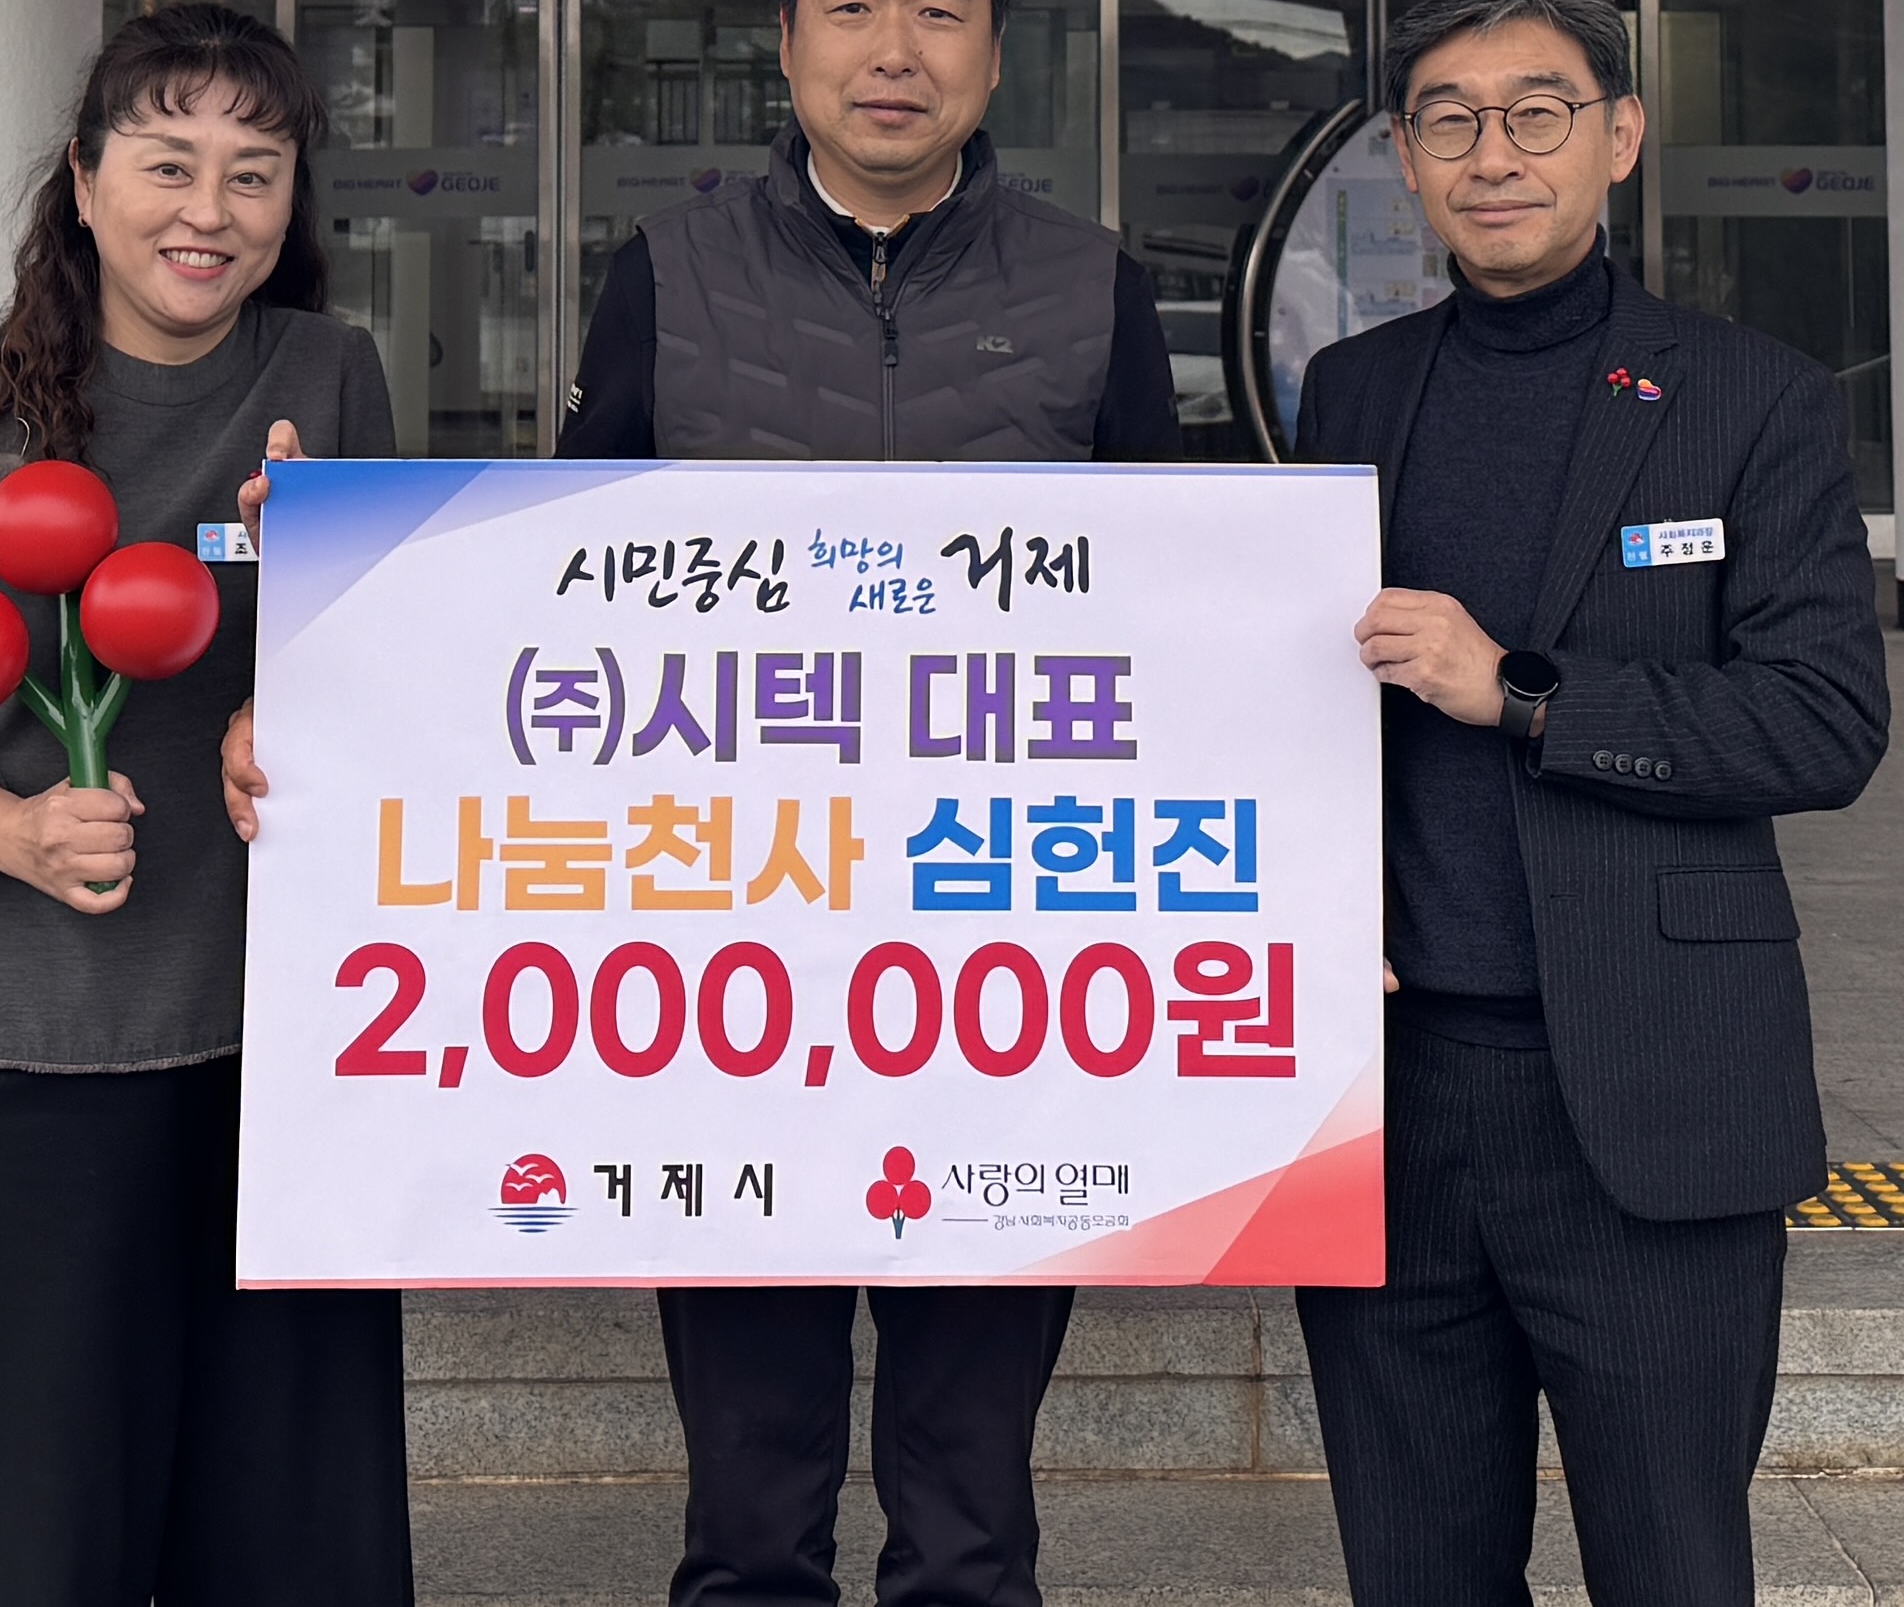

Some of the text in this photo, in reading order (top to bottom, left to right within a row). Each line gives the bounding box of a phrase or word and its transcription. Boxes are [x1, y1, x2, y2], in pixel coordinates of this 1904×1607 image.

[441, 176, 500, 192] GEOJE
[1815, 174, 1875, 191] GEOJE
[976, 335, 1015, 355] K2
[555, 525, 1091, 615] 시민중심 희망의 새로운 거제
[909, 651, 1138, 764] 대표
[377, 794, 1260, 912] 나눔천사 심헌진
[334, 939, 1297, 1088] 2,000,000원
[941, 1162, 1045, 1207] 사랑의
[1055, 1162, 1129, 1206] 열매
